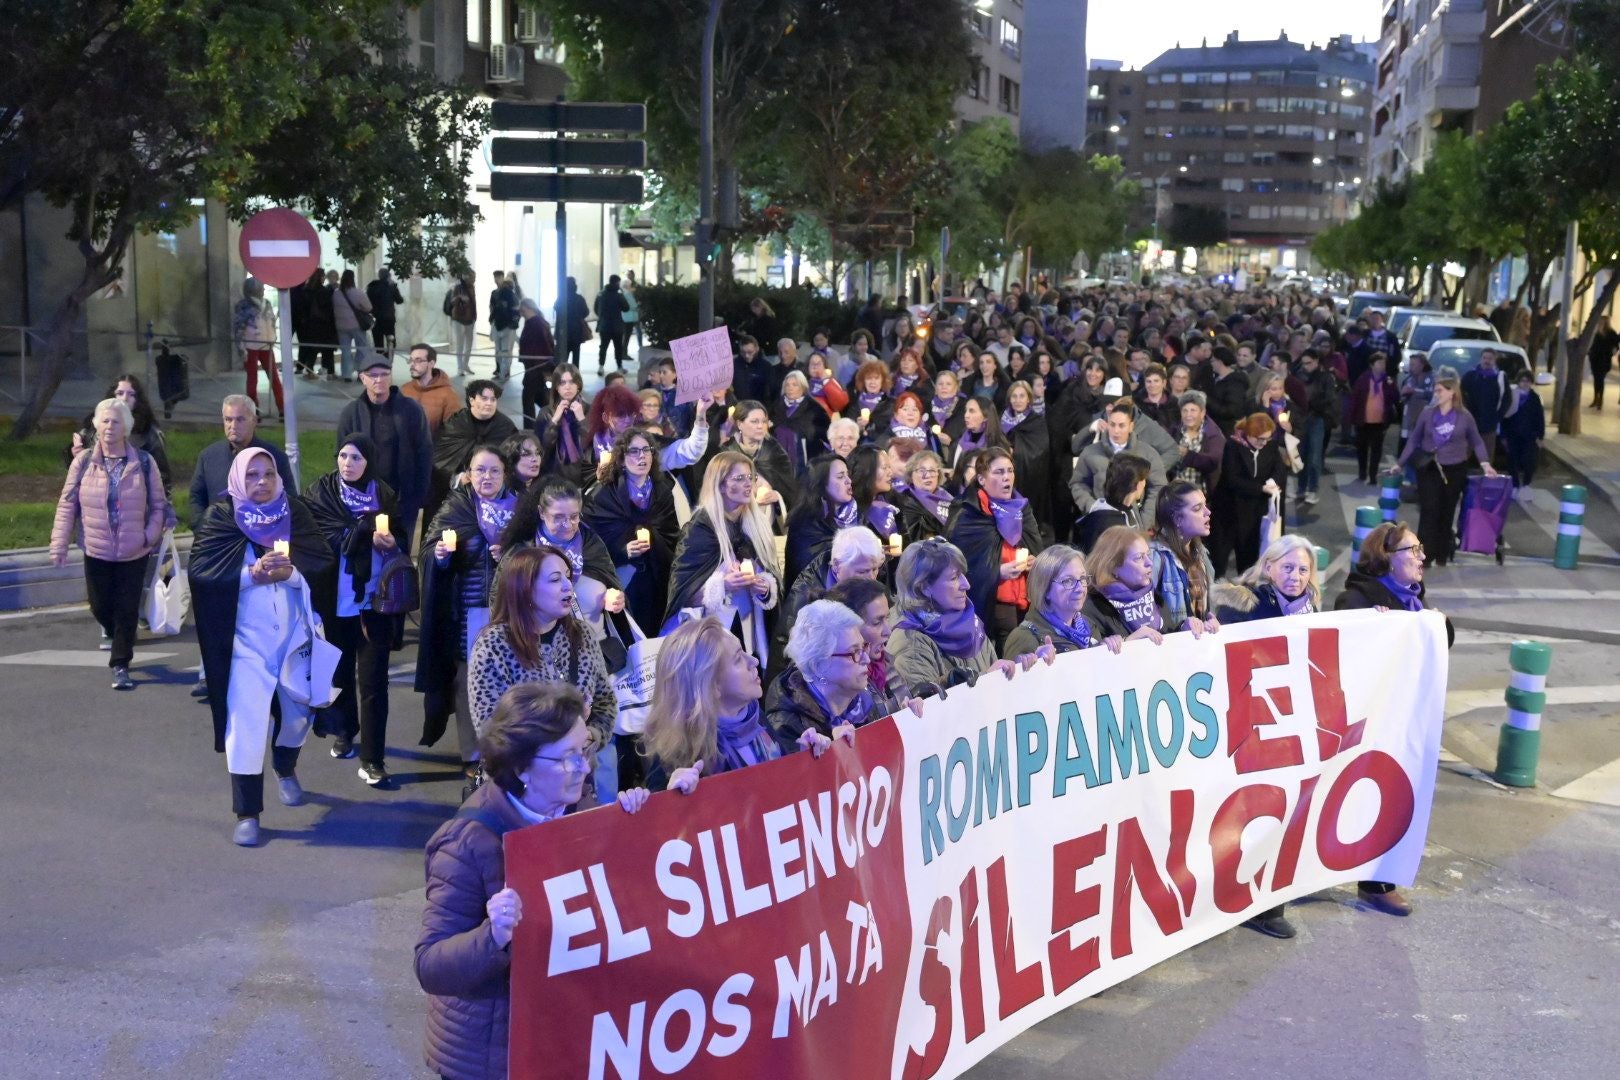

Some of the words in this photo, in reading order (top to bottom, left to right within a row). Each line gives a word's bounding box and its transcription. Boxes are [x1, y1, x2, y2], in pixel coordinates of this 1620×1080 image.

[919, 671, 1219, 866] ROMPAMOS
[1225, 628, 1366, 774] EL
[543, 862, 651, 978] EL
[655, 765, 892, 938] SILENCIO
[901, 750, 1414, 1080] SILENCIO
[588, 973, 755, 1080] NOS
